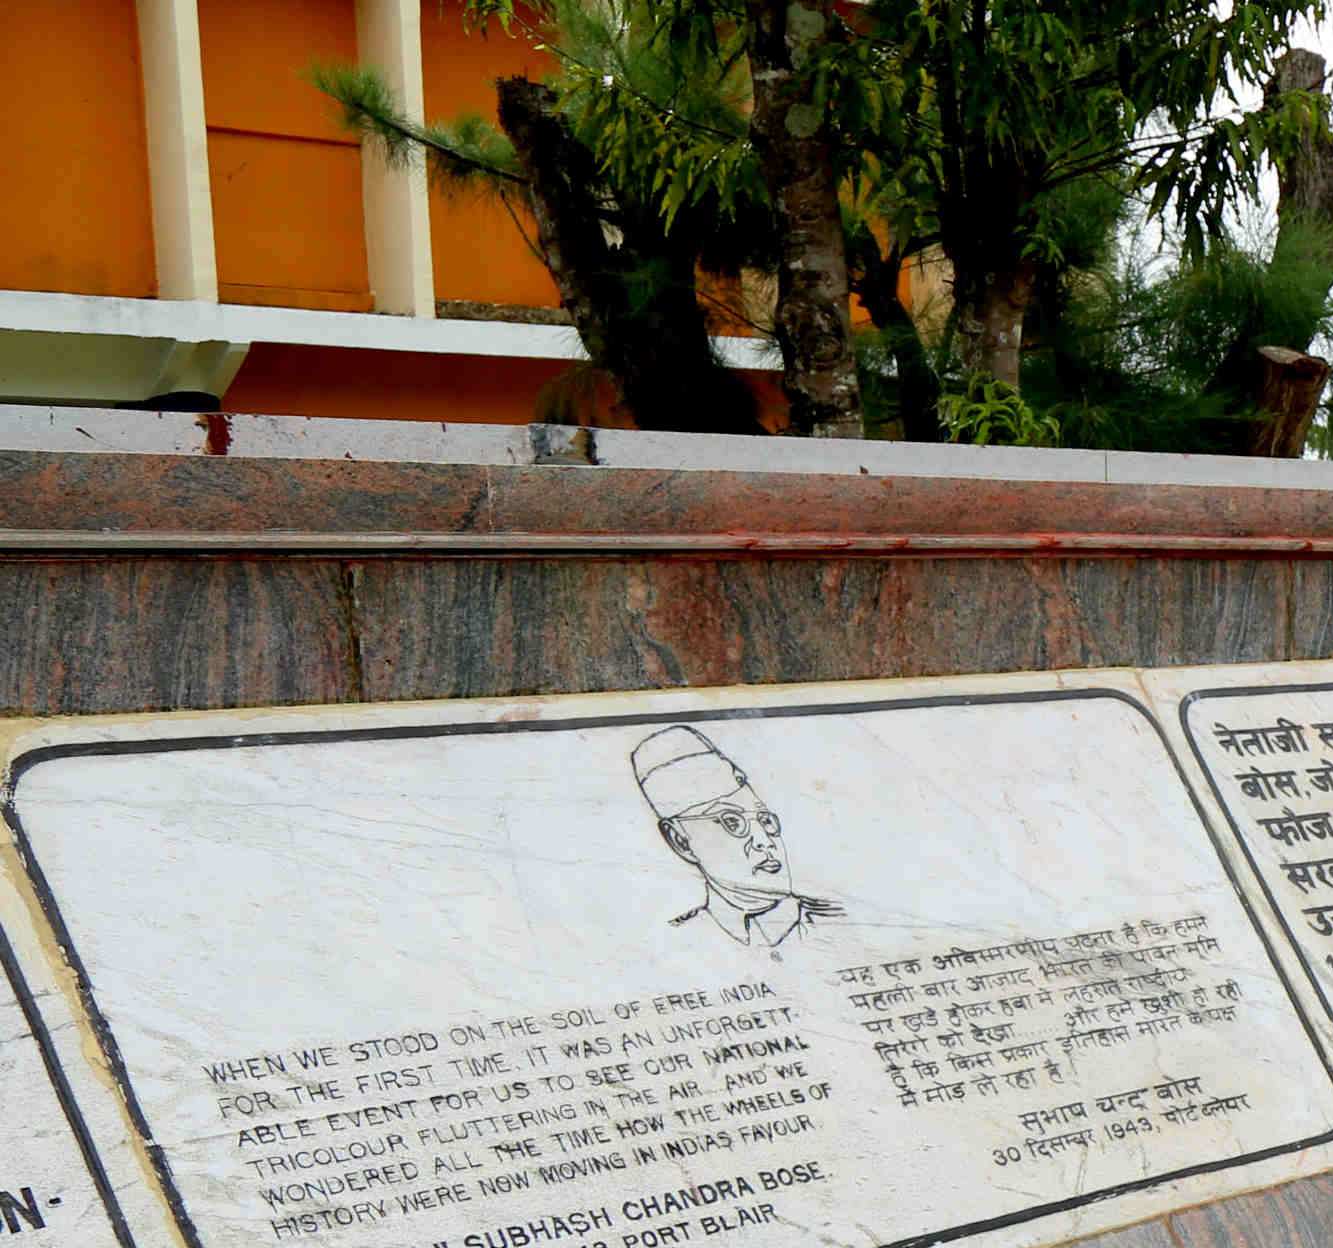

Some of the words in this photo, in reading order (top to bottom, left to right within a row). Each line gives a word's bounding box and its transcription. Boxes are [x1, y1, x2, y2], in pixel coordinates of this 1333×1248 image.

[1212, 717, 1309, 757] नेताजी
[836, 966, 875, 987] यह
[880, 958, 921, 980] एक
[848, 983, 915, 1011] पहली
[921, 979, 960, 997] बार
[202, 1054, 287, 1085] WHEN
[293, 1046, 339, 1071] WE
[350, 1032, 438, 1063] STOOD
[450, 1025, 486, 1046] ON
[491, 1016, 542, 1039] THE
[551, 1007, 606, 1030] SOIL
[614, 1000, 641, 1020] OF
[720, 981, 776, 1004] INDIA
[861, 1018, 895, 1035] पर
[937, 1028, 964, 1048] को
[217, 1091, 277, 1119] FOR
[286, 1080, 345, 1105] THE
[356, 1065, 434, 1094] FIRST
[525, 1047, 548, 1068] IT
[560, 1036, 613, 1060] WAS
[622, 1031, 654, 1056] AN
[237, 1120, 315, 1147] ABLE
[326, 1100, 417, 1132] EVENT
[430, 1089, 483, 1113] FOR
[491, 1081, 531, 1102] US
[540, 1075, 574, 1094] TO
[585, 1063, 634, 1087] SEE
[643, 1054, 693, 1076] OUR
[702, 1035, 810, 1068] NATIONAL
[246, 1134, 408, 1179] TRICOLOUR
[417, 1103, 577, 1145] FLUTTERING
[585, 1098, 610, 1120] IN
[613, 1088, 658, 1111] THE
[776, 1061, 809, 1081] WE
[1018, 1101, 1089, 1136] सुभाष
[1154, 1075, 1203, 1100] बोस
[259, 1162, 419, 1213] WONDERED
[433, 1152, 483, 1176] ALL
[489, 1138, 542, 1163] THE
[552, 1127, 611, 1152] TIME
[615, 1116, 665, 1138] HOW
[674, 1105, 720, 1128] THE
[725, 1089, 805, 1118] WHEELS
[809, 1082, 832, 1101] OF
[992, 1146, 1021, 1167] 30
[271, 1200, 387, 1240] HISTORY
[395, 1184, 471, 1215] WERE
[478, 1172, 529, 1197] NOW
[539, 1152, 626, 1186] MOVING
[632, 1146, 657, 1167] IN
[622, 1176, 755, 1222] CHANDRA
[701, 1203, 778, 1237] BLAIR
